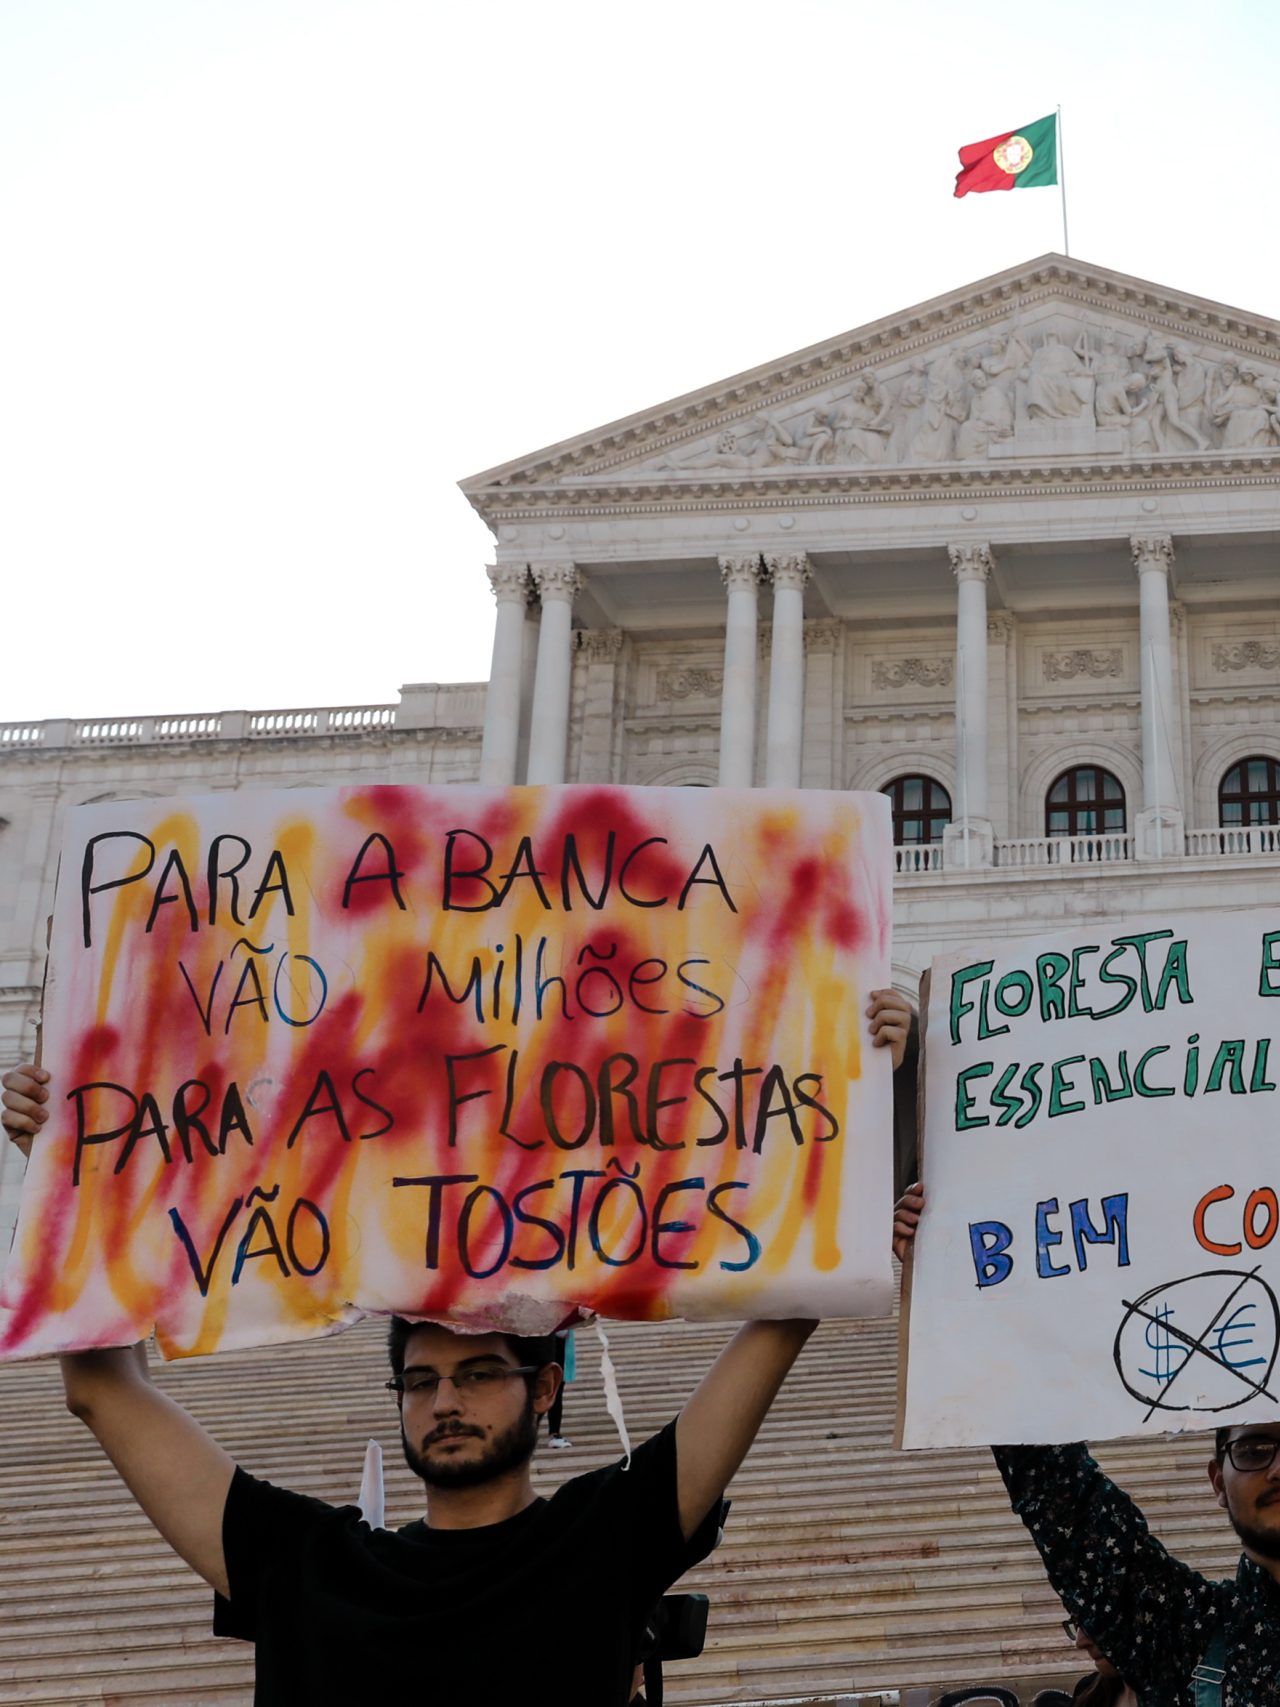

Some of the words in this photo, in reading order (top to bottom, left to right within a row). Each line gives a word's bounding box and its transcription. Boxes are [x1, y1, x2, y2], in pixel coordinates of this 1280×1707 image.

[81, 830, 295, 948] PARA
[341, 832, 407, 912] A
[441, 829, 739, 914] BANCA
[178, 938, 328, 1037] VÃO
[950, 929, 1194, 1046] FLORESTA
[67, 1079, 255, 1187] PARA
[288, 1068, 396, 1149] AS
[446, 1044, 840, 1156] FLORESTAS
[169, 1184, 331, 1298] VÃO
[393, 1161, 762, 1280] TOSTÕES
[968, 1193, 1132, 1289] BEM
